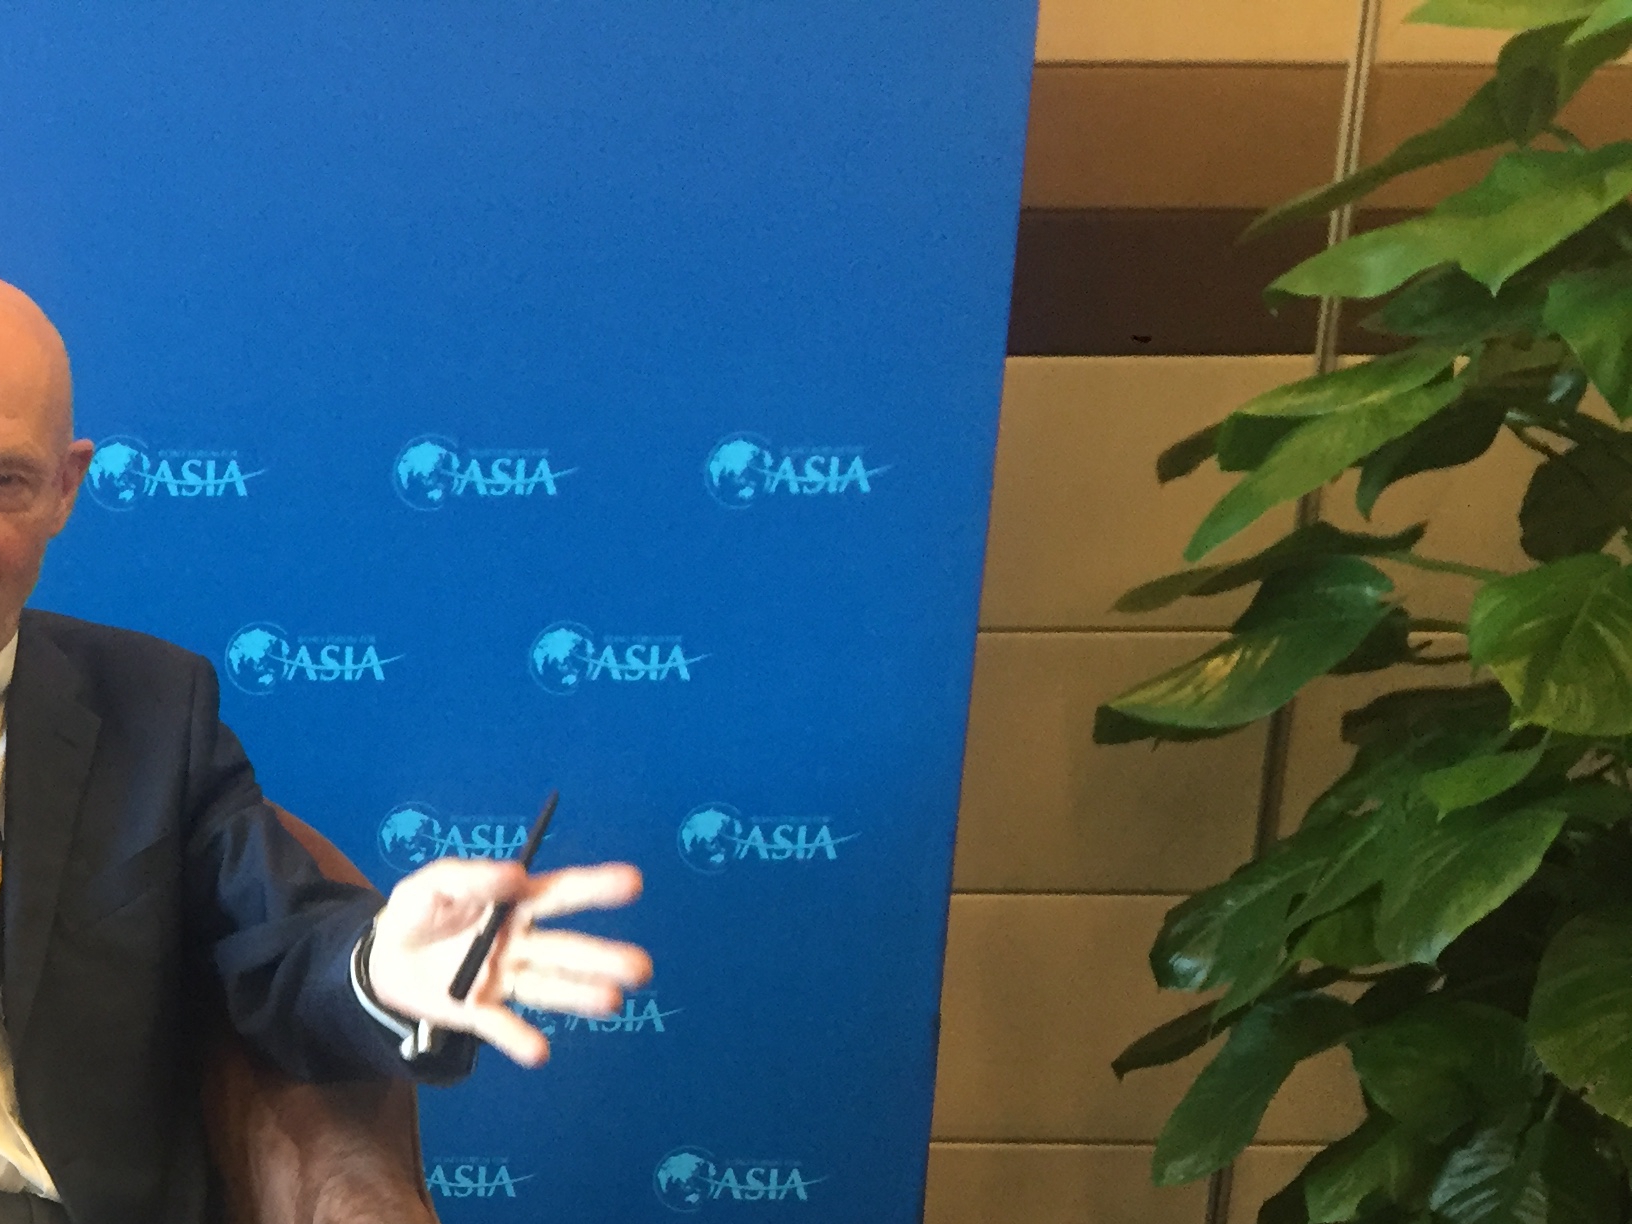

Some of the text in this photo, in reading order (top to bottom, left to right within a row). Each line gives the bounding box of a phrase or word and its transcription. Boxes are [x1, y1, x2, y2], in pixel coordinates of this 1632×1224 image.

[147, 459, 248, 497] ASIA
[455, 458, 557, 496] ASIA
[768, 455, 871, 495] ASIA
[286, 644, 386, 681] ASIA
[590, 644, 690, 682] ASIA
[738, 824, 838, 860] ASIA
[427, 1164, 516, 1198] ASIA
[712, 1167, 808, 1201] ASIA
